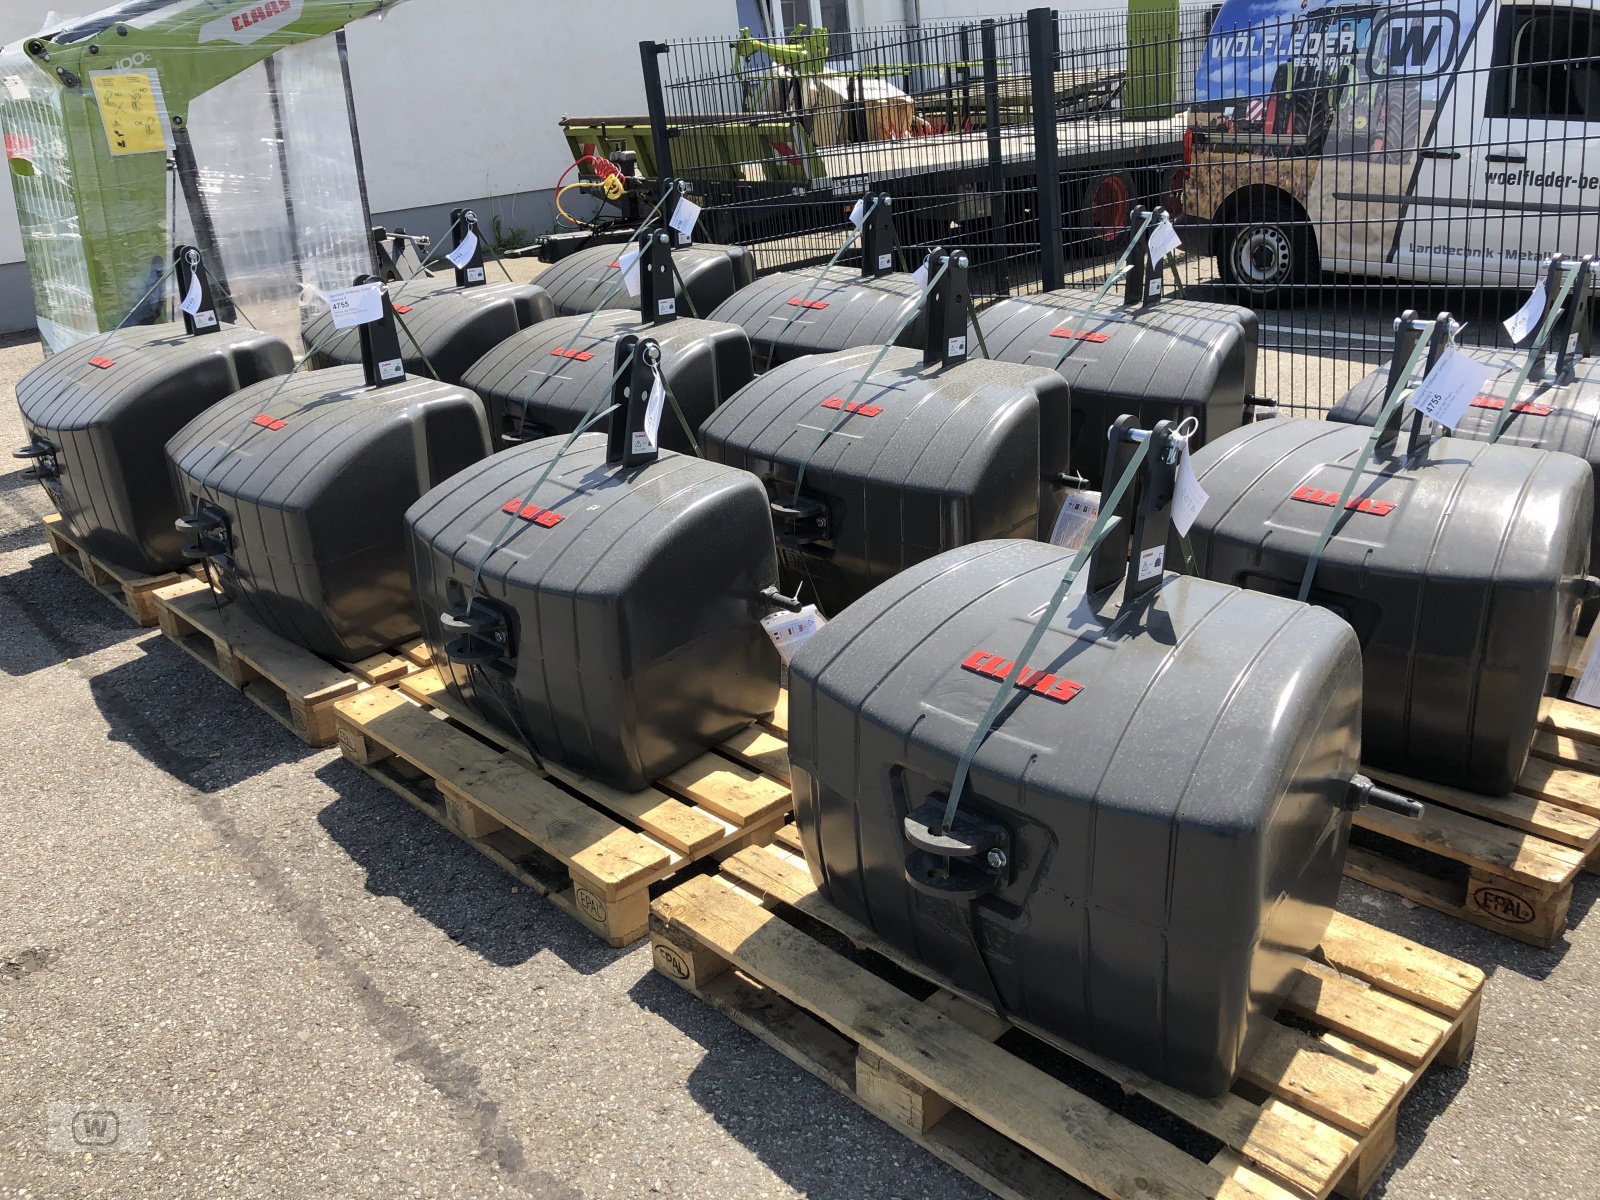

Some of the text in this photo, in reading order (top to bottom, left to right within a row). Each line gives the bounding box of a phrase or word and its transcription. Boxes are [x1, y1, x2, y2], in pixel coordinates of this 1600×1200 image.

[231, 0, 291, 32] CLAAS
[1211, 32, 1355, 58] WÖLFLEDER
[1390, 25, 1443, 66] W
[1409, 242, 1494, 258] Landtechnik
[333, 301, 350, 310] 4755
[1426, 394, 1442, 413] 4755
[580, 891, 604, 920] EPAL
[1484, 891, 1526, 921] EPAL
